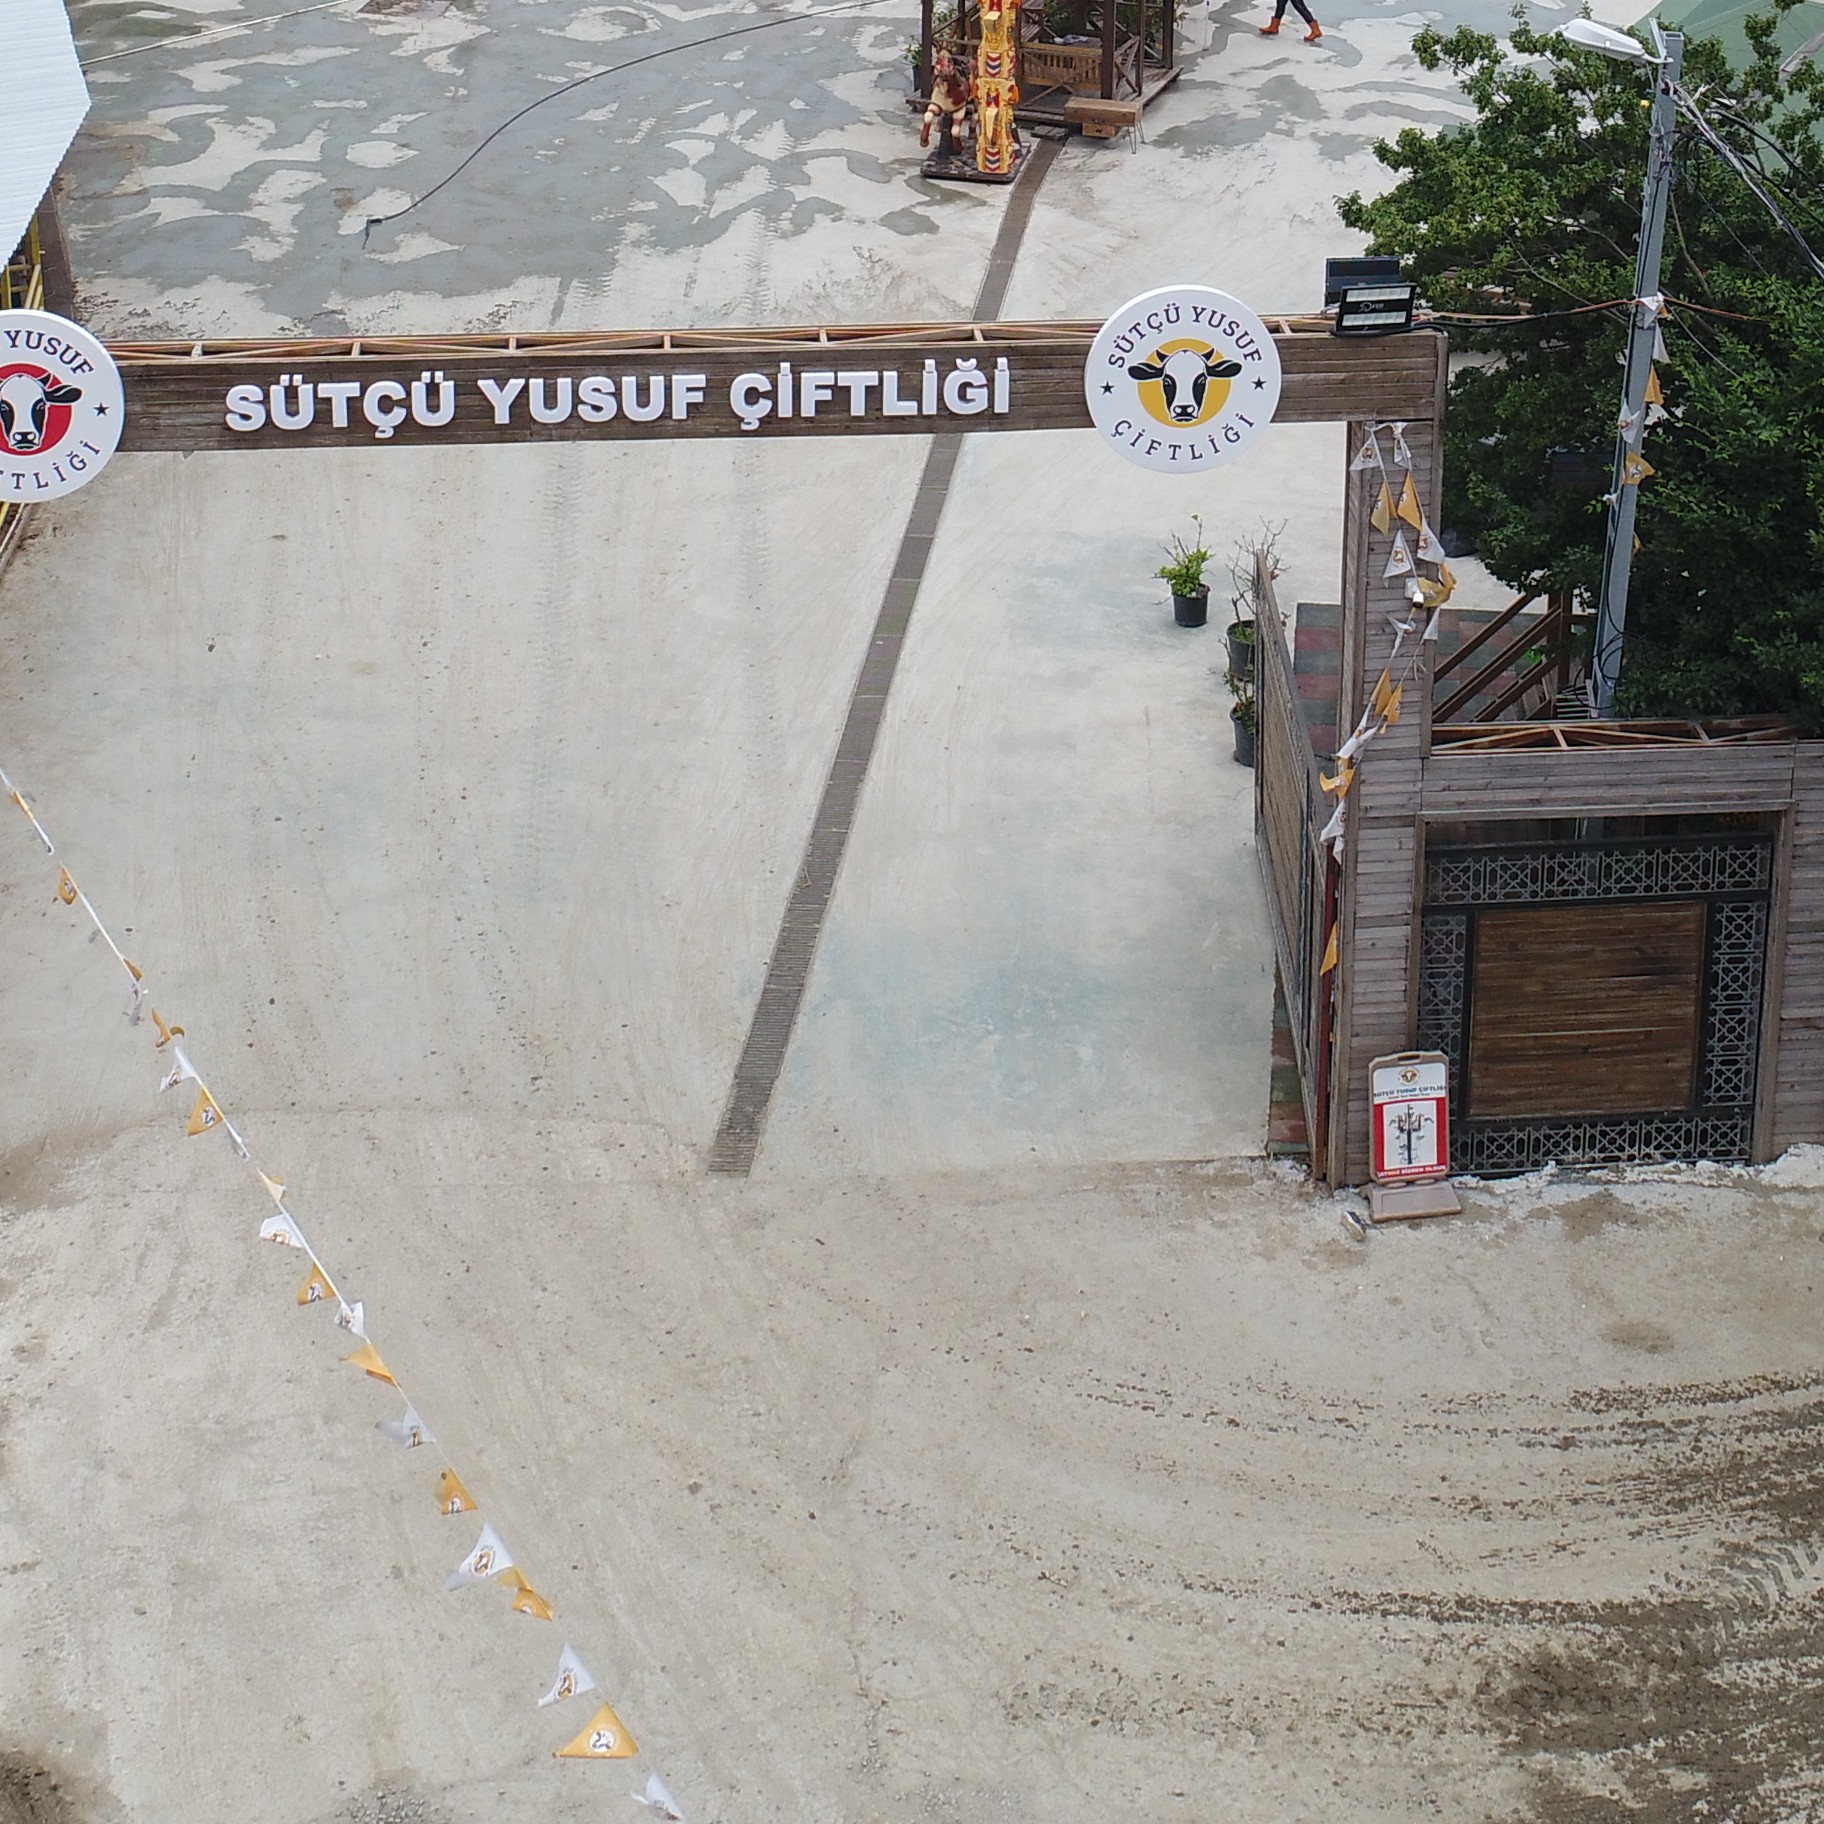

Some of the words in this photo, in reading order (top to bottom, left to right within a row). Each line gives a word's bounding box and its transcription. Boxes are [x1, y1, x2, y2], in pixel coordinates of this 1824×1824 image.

[4, 329, 95, 376] YUSUF
[1108, 302, 1181, 369] SÜTÇÜ
[1191, 305, 1263, 363] YUSUF
[224, 370, 456, 439] SÜTÇÜ
[476, 373, 707, 425] YUSUF
[728, 356, 1011, 431] ÇİFTLİĞİ
[1110, 412, 1256, 461] ÇİFTLİĞİ
